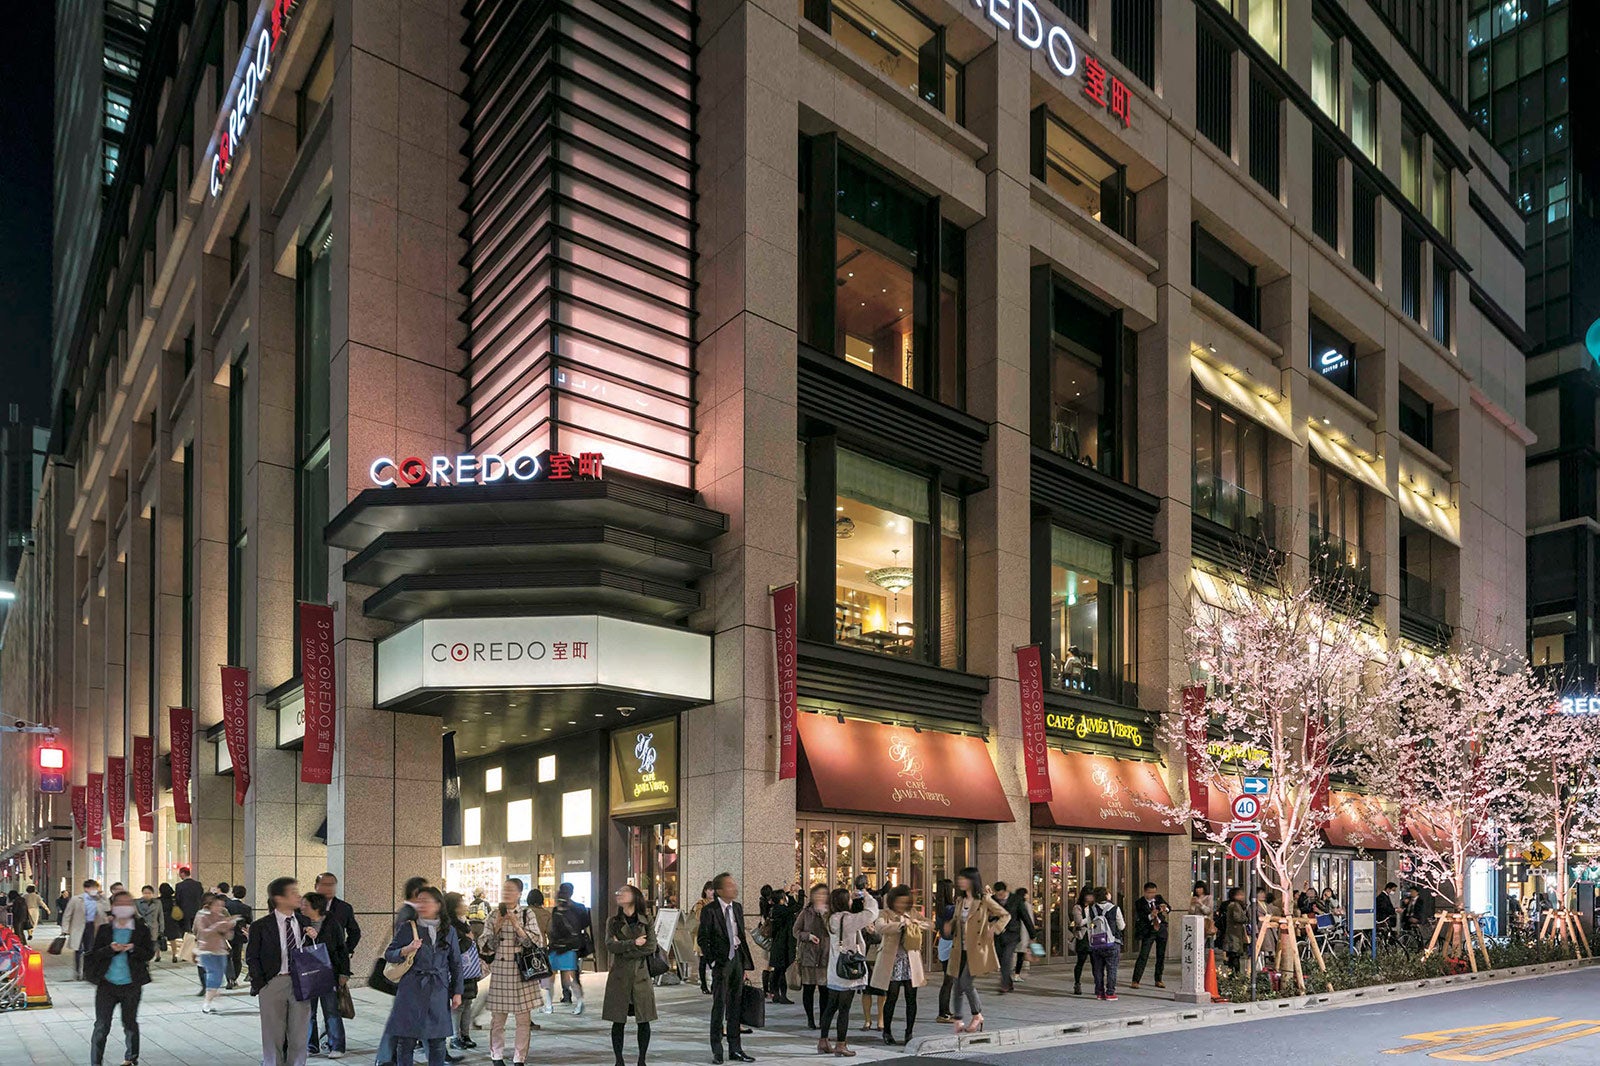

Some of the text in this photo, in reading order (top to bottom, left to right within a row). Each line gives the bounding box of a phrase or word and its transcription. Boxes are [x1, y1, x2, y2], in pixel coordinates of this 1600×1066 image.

[974, 0, 1132, 128] EDO 室町
[210, 28, 270, 197] COREDO
[370, 452, 604, 486] COREDO 室町
[431, 641, 589, 662] COREDO 室町
[1046, 713, 1142, 747] CAFÉ AIMÉE VIBERT
[1237, 801, 1254, 814] 40
